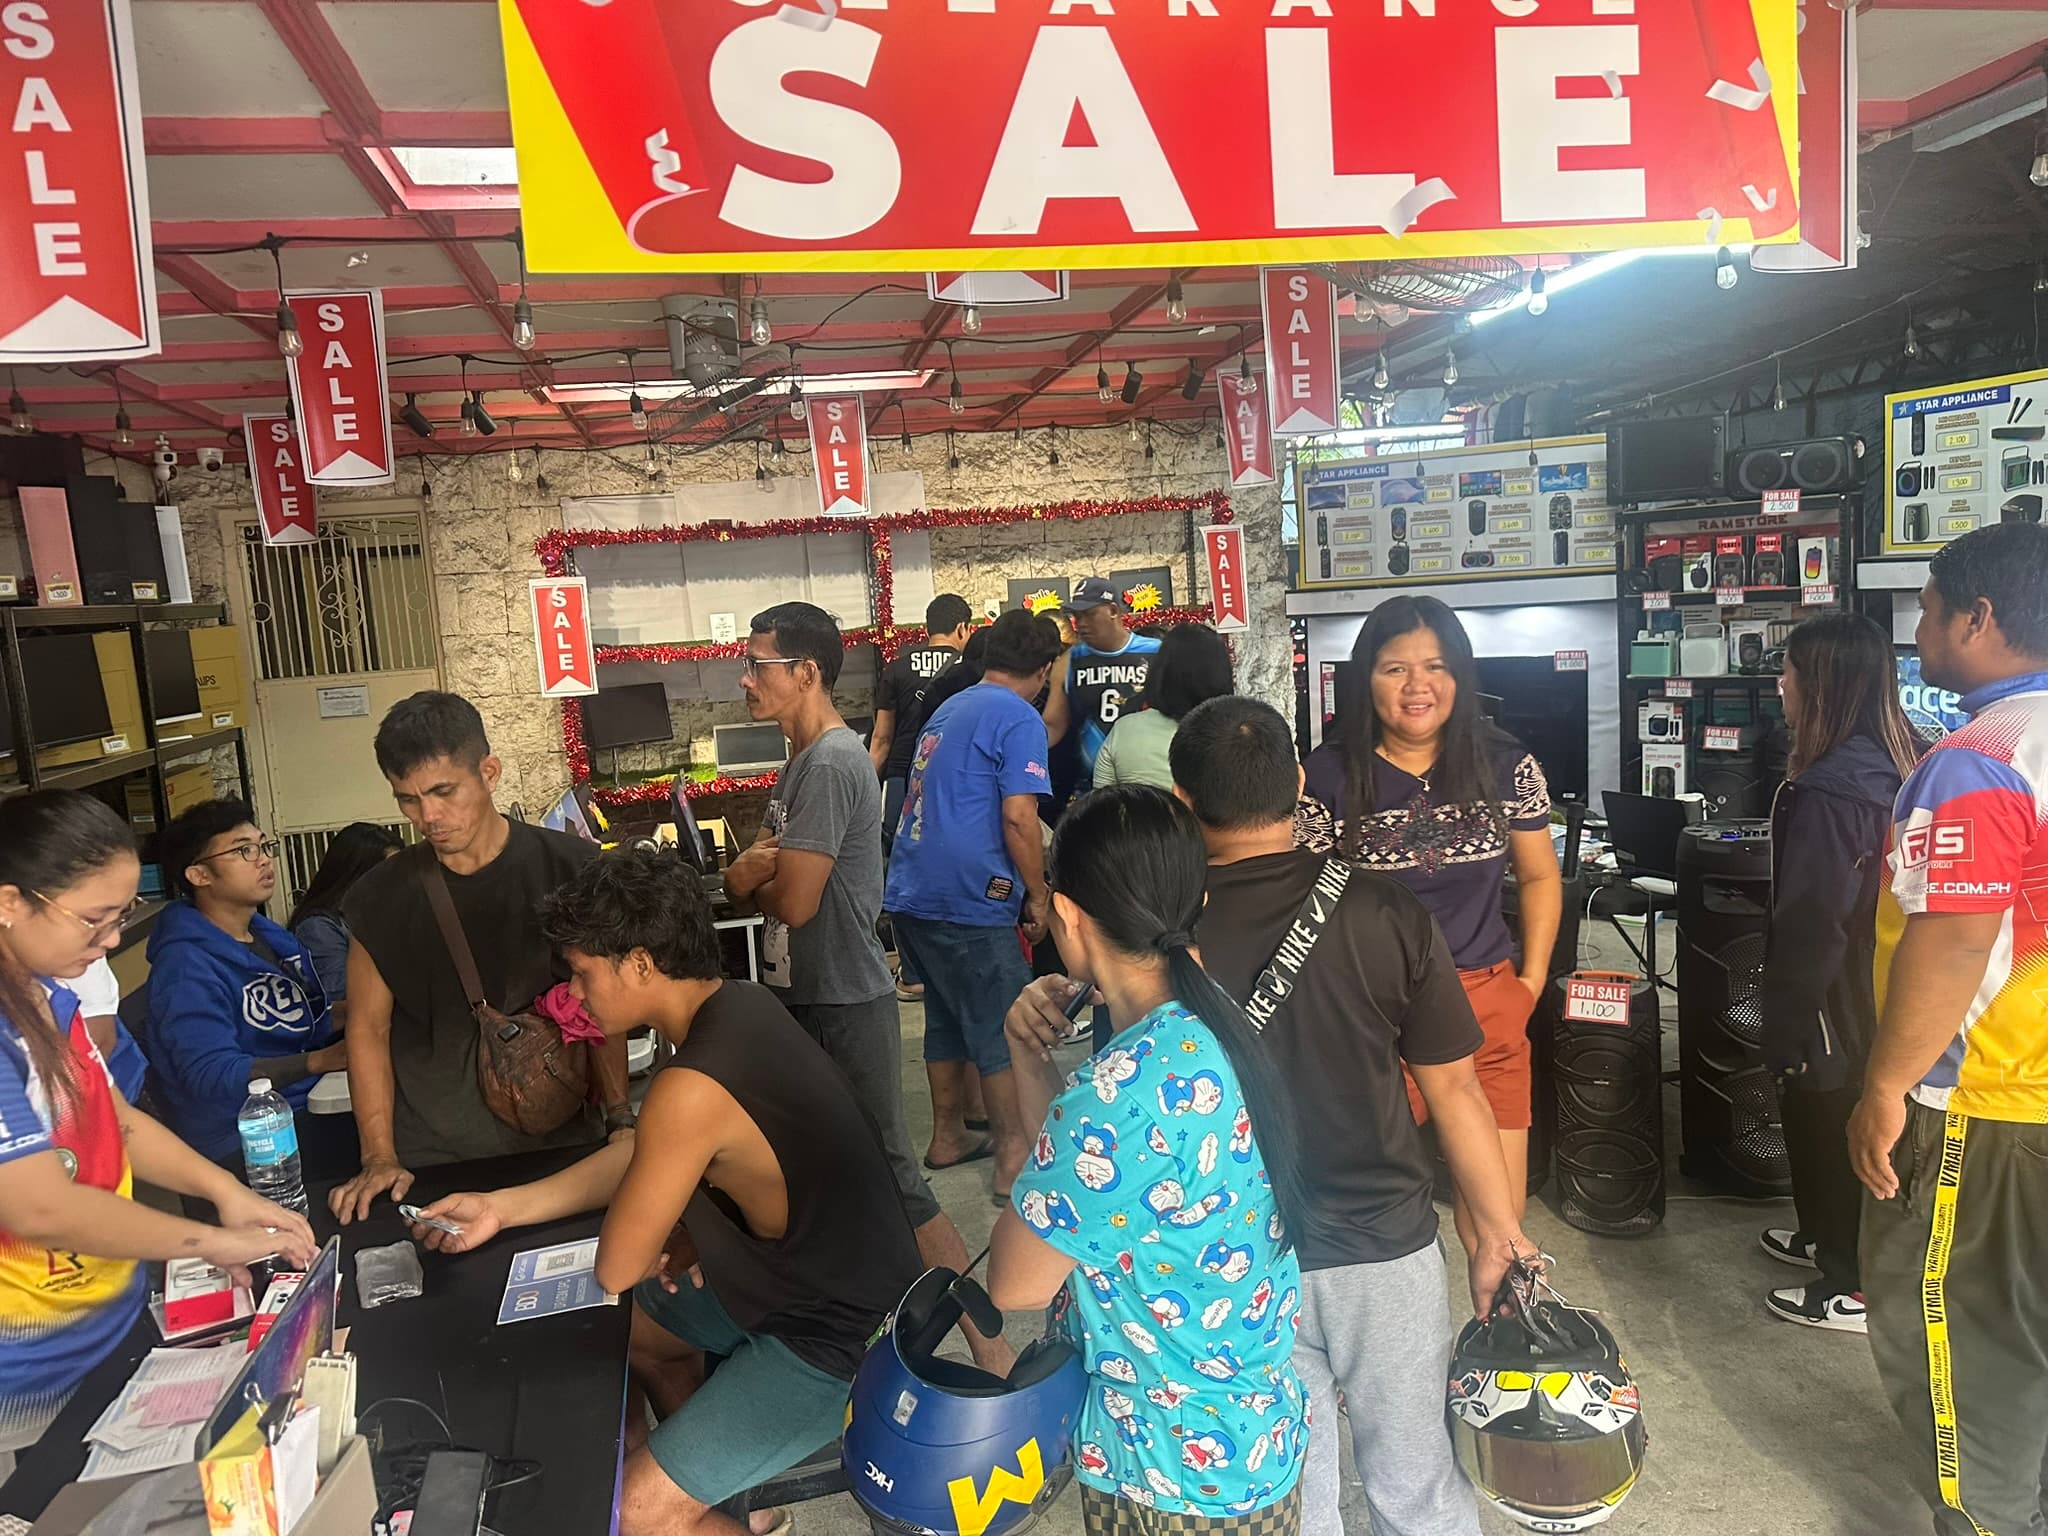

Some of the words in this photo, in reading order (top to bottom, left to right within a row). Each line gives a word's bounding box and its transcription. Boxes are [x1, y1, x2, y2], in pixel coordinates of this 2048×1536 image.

[3, 2, 87, 276] SALE
[709, 14, 1646, 239] SALE
[1288, 275, 1311, 399] SALE
[318, 303, 360, 441] SALE
[1915, 397, 1938, 411] STAR
[1942, 390, 1998, 408] APPLIANCE
[827, 402, 851, 490] SALE
[271, 423, 299, 517] SALE
[1319, 471, 1335, 479] TAR
[1338, 466, 1386, 478] APPLIANCE
[1764, 492, 1778, 500] FOR
[1780, 491, 1798, 500] SALE
[1698, 514, 1787, 530] RAMSTORE
[1216, 535, 1233, 608] SALE
[551, 587, 575, 671] SALE
[1076, 665, 1147, 687] PILIPINAS
[1100, 689, 1120, 723] 6
[1899, 684, 1961, 714] ace
[1316, 859, 1350, 902] NIKE
[1275, 919, 1319, 974] NIKE
[1245, 990, 1277, 1034] IKE
[1571, 984, 1594, 998] FOR
[1598, 987, 1626, 1001] SALE
